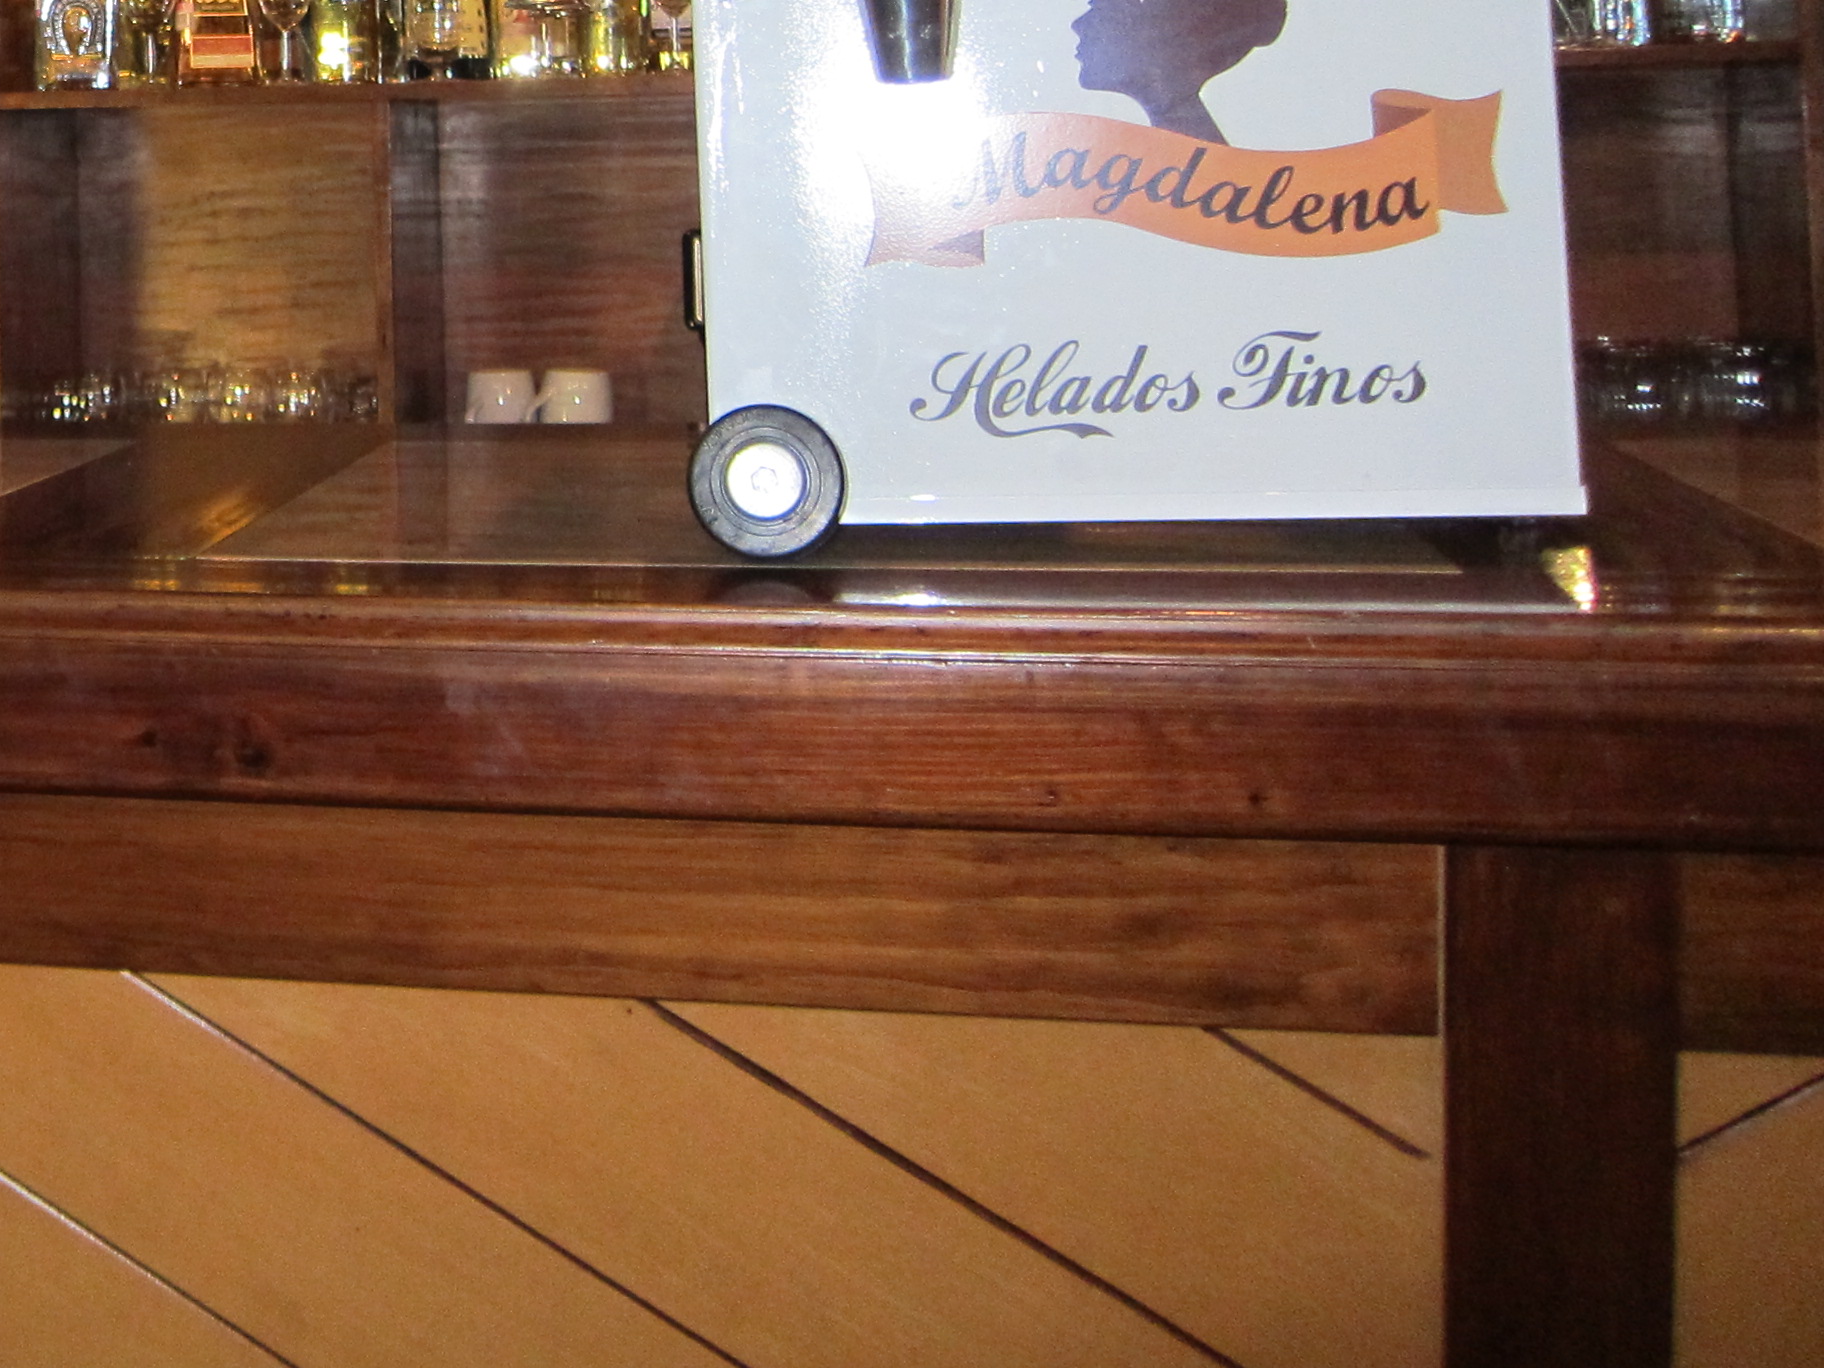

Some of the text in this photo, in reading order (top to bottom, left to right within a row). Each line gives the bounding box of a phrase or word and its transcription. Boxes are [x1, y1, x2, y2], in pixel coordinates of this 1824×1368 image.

[953, 129, 1429, 234] Magdalena
[909, 331, 1427, 438] Helados Finos
